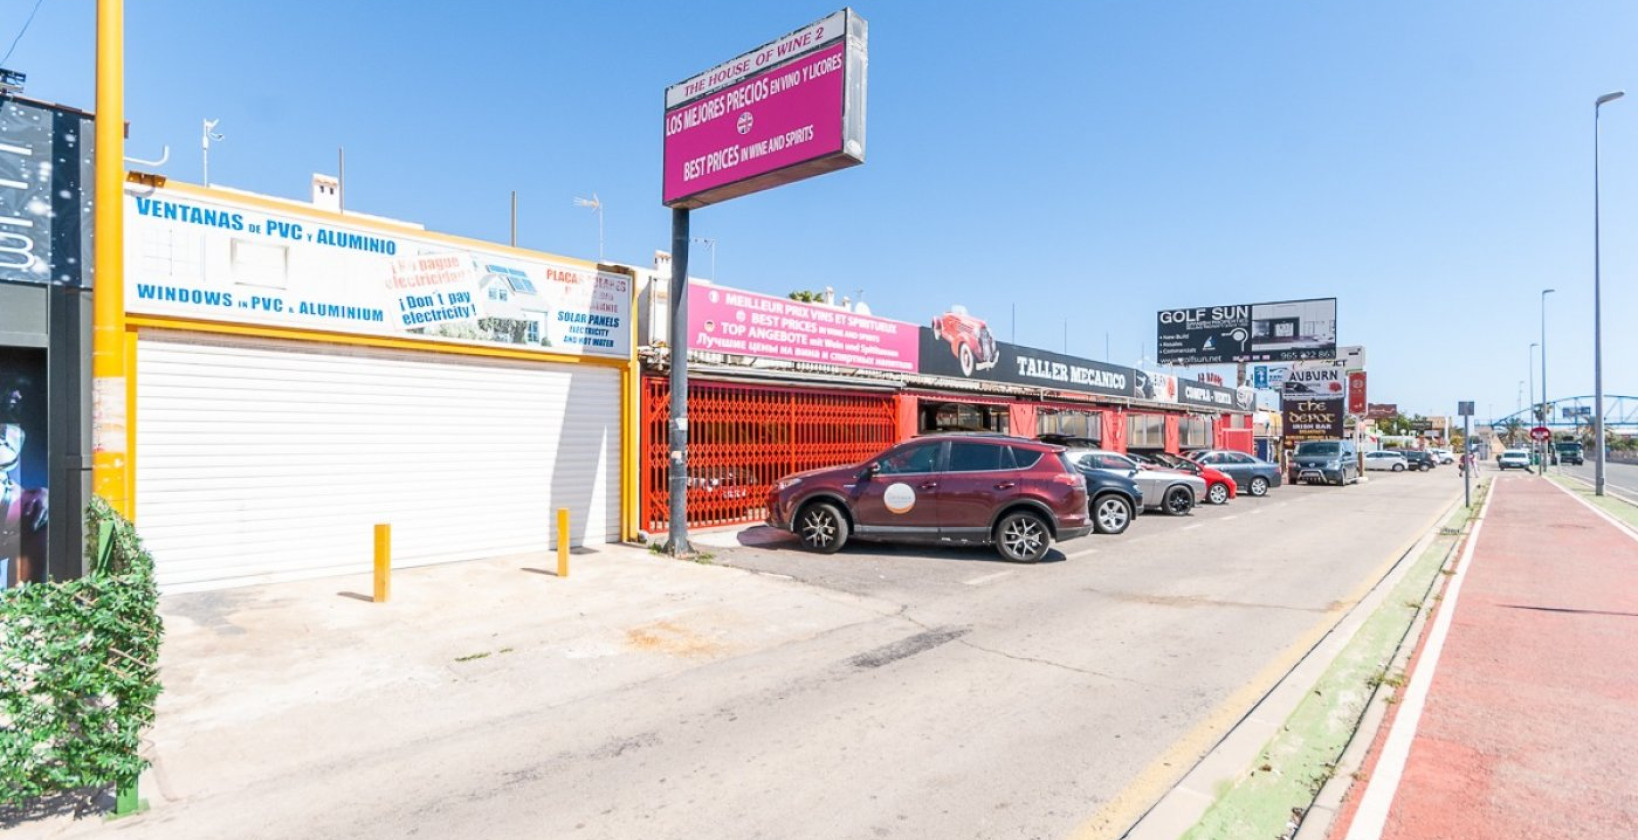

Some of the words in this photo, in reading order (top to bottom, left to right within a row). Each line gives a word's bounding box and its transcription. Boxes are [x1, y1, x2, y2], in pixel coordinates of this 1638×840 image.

[684, 78, 706, 98] THE
[708, 61, 751, 87] HOUSE
[755, 49, 774, 67] OF
[777, 31, 812, 58] WINE
[815, 26, 824, 41] 2
[666, 112, 683, 137] LOS
[683, 95, 726, 131] MEJORES
[726, 77, 769, 114] PRECIOS
[770, 80, 781, 96] EN
[780, 70, 800, 93] VINO
[802, 67, 809, 83] Y
[808, 52, 842, 81] LICORES
[683, 156, 707, 182] BEST
[706, 144, 739, 175] PRICES
[740, 149, 749, 163] IN
[748, 139, 769, 160] WINE
[767, 132, 786, 154] AND
[785, 124, 814, 149] SPIRITS
[136, 196, 244, 231] VENTANAS
[249, 223, 261, 234] DE
[266, 219, 303, 240] PVC
[307, 233, 313, 242] Y
[316, 228, 396, 256] ALUMINIO
[137, 283, 233, 307] WINDOWS
[238, 299, 248, 309] IN
[251, 296, 283, 313] PVC
[299, 301, 384, 322] ALUMINIUM
[447, 291, 471, 306] pay
[557, 311, 587, 323] SOLAR
[588, 314, 620, 328] PANELS
[725, 292, 783, 315] MEILLEUR
[785, 304, 809, 319] PRIX
[810, 308, 834, 324] VINS
[835, 313, 847, 325] ET
[847, 315, 897, 334] SPIRITUEUX
[751, 312, 780, 328] BEST
[781, 317, 817, 334] PRICES
[1160, 308, 1207, 324] GOLF
[1211, 305, 1249, 321] SUN
[563, 335, 577, 344] AND
[578, 336, 591, 346] HOT
[592, 338, 614, 348] WATER
[569, 325, 610, 337] ELECTRICITY
[696, 332, 746, 349] Лучшие
[721, 321, 746, 337] TOP
[748, 326, 809, 345] ANGEBOTE
[809, 337, 823, 346] mit
[824, 338, 844, 349] Wein
[1017, 355, 1069, 382] TALLER
[1070, 365, 1126, 390] MECANICO
[1289, 369, 1338, 381] AUBURN
